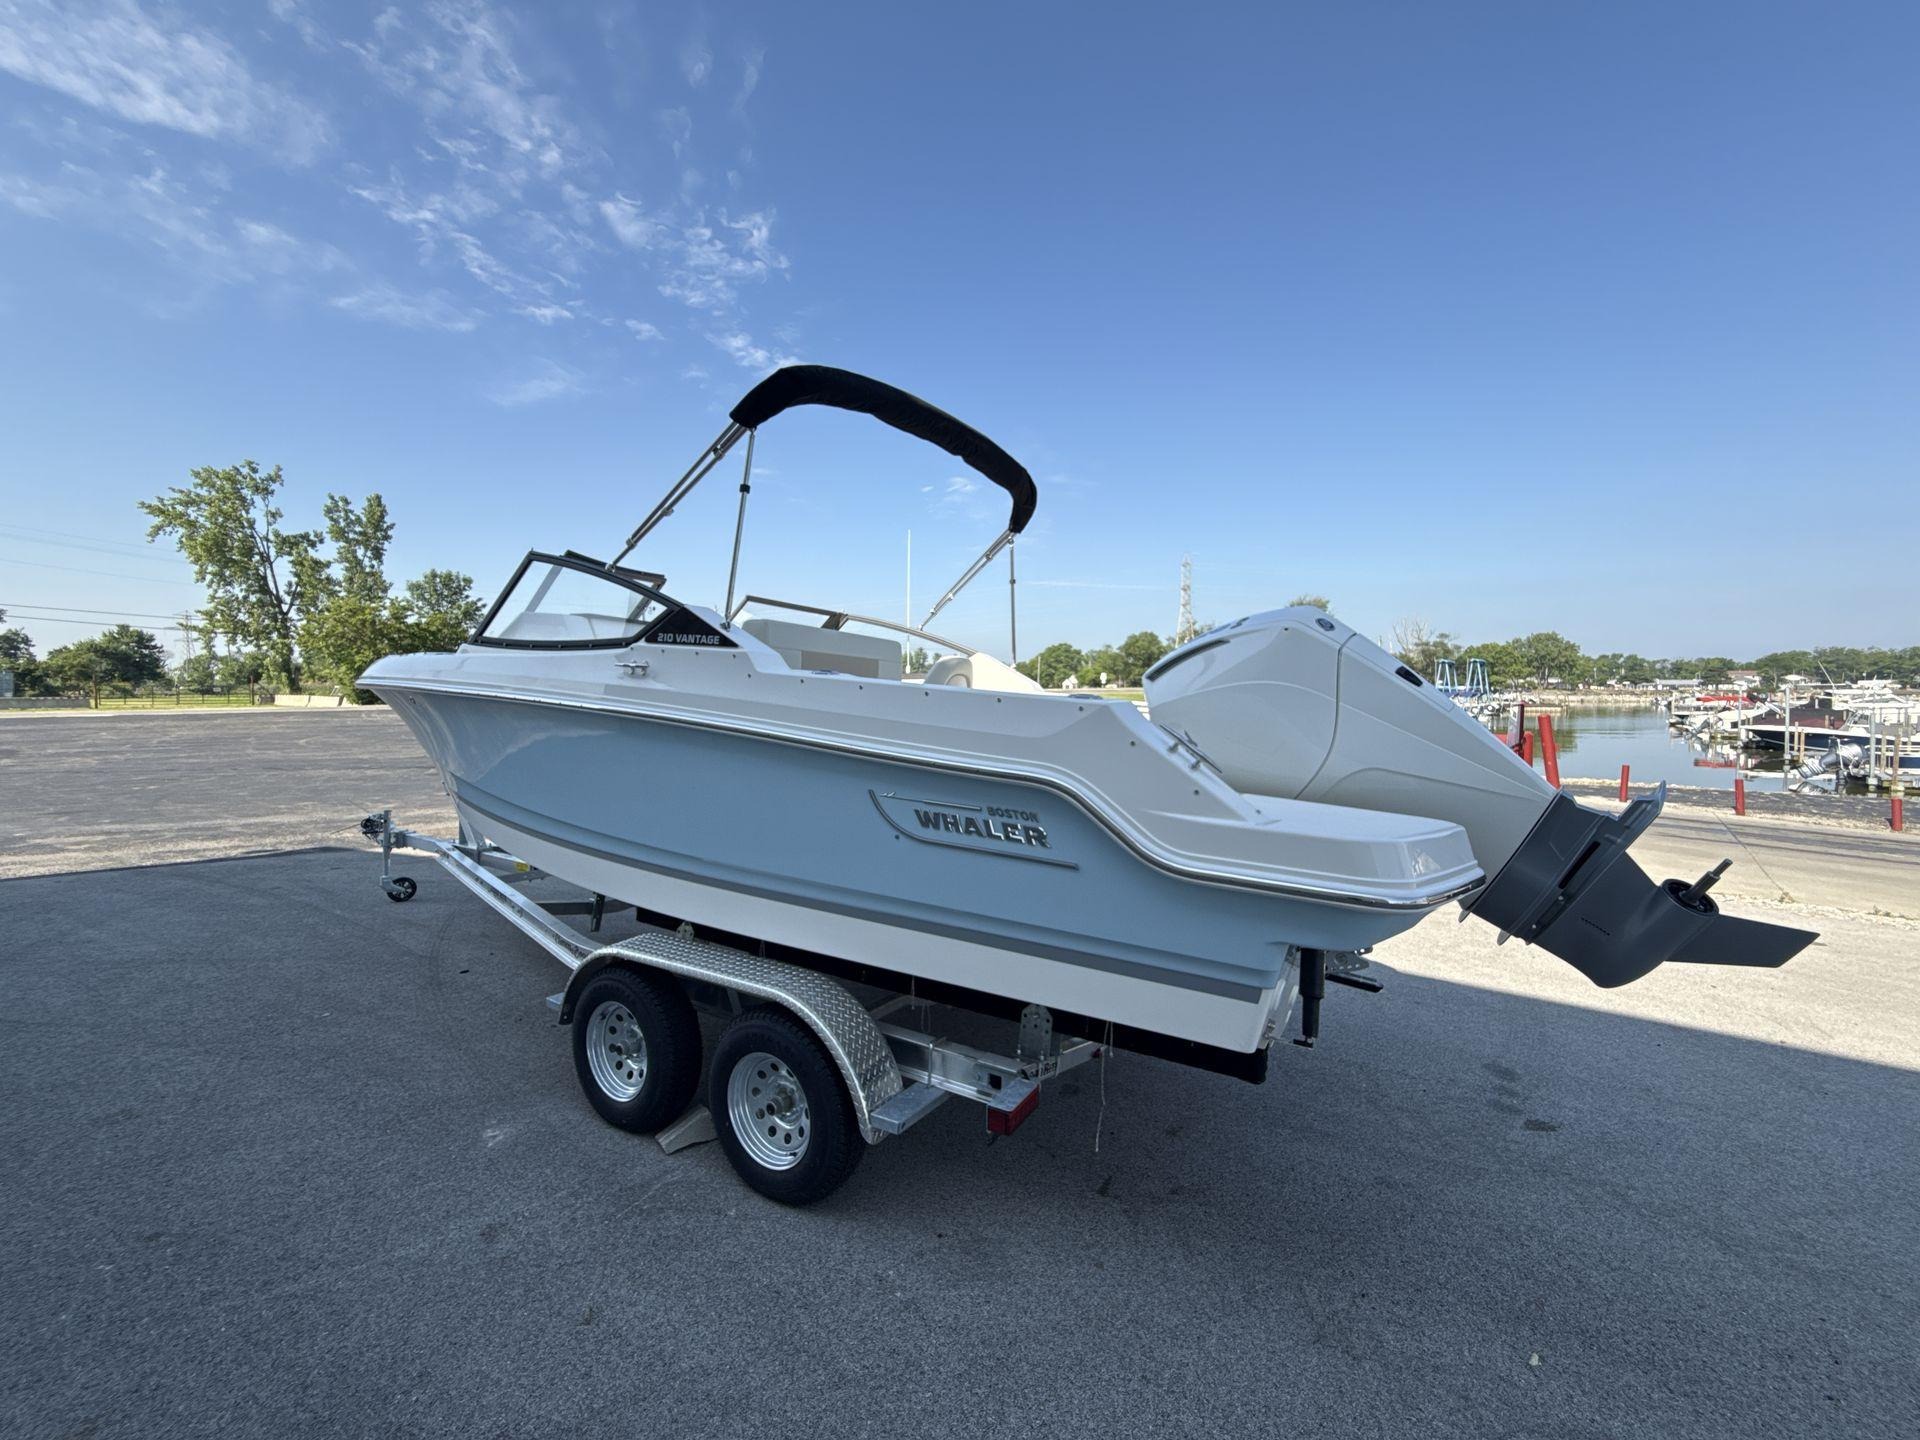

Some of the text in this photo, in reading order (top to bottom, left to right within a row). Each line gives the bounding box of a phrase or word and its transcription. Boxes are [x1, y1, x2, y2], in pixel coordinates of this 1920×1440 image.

[657, 633, 721, 645] 210 VANTAGE
[987, 806, 1040, 823] BOSTON
[914, 808, 1052, 848] WHALER
